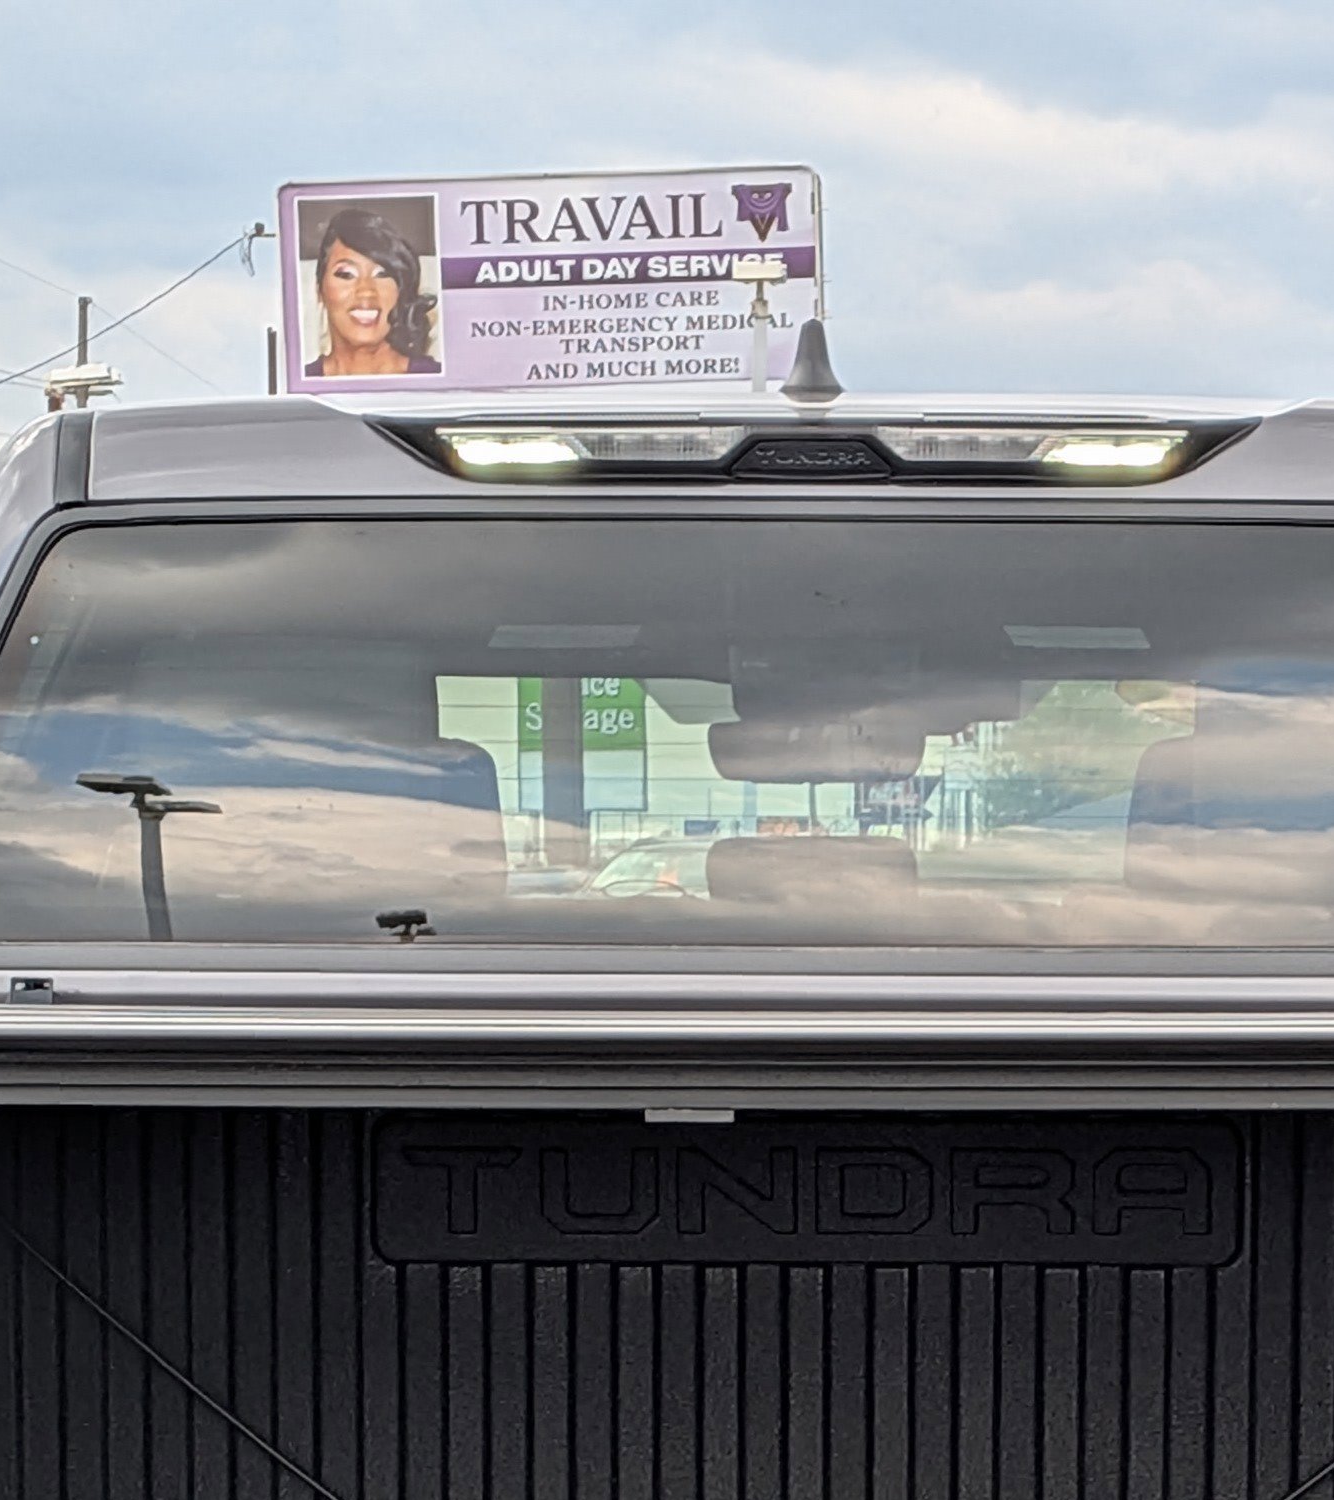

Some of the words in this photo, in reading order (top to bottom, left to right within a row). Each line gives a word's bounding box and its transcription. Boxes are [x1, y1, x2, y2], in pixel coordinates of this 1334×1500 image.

[460, 193, 722, 245] TRAVAIL
[475, 259, 576, 283] ADULT
[581, 257, 640, 280] DAY
[542, 291, 648, 311] IN-HOME
[654, 289, 720, 308] CARE
[470, 316, 678, 338] NON-EMERGENCY
[559, 334, 705, 355] TRANSPORT
[527, 362, 578, 381] AND
[585, 359, 656, 378] MUCH
[665, 357, 740, 375] MORE!
[525, 702, 635, 734] Sage
[401, 1145, 1214, 1236] TUNDRA
